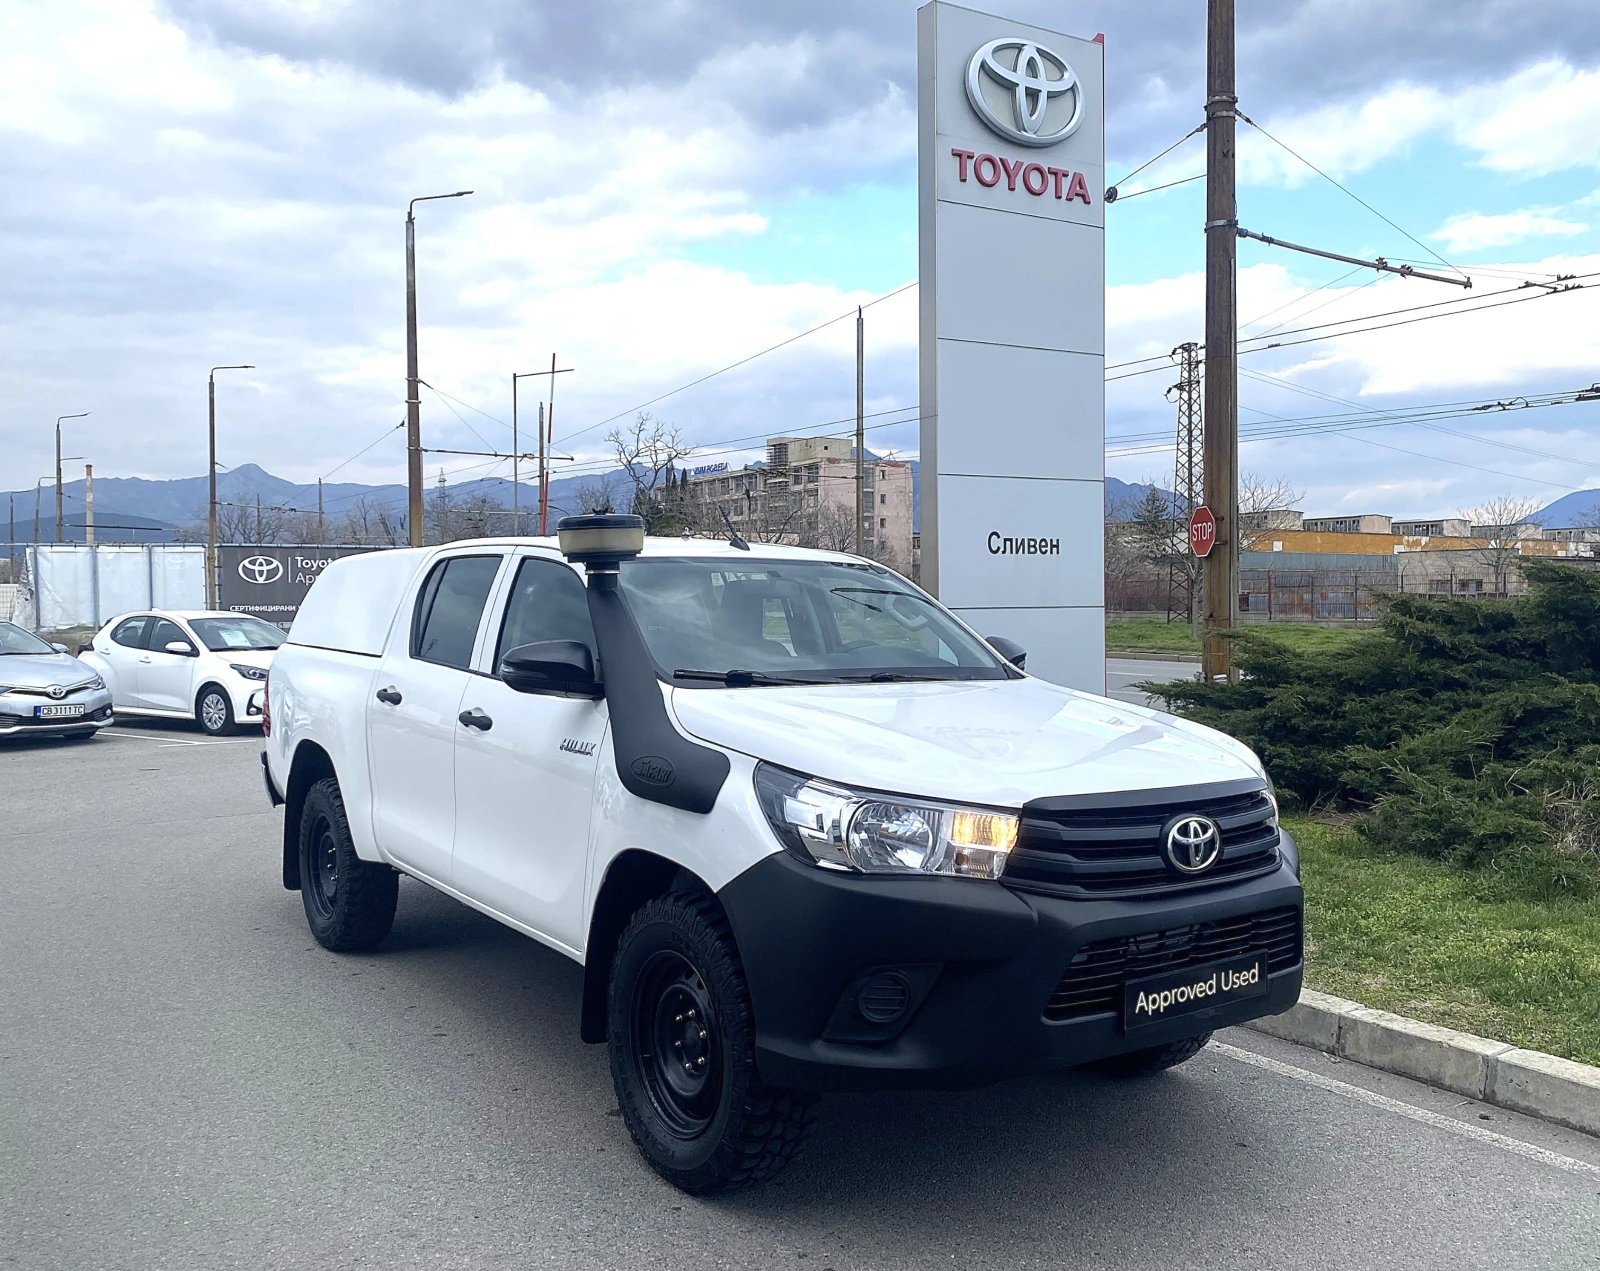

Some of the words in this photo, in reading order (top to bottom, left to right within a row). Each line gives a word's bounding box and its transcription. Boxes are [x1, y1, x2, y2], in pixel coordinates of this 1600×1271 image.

[951, 147, 1091, 205] TOYOTA
[987, 530, 1060, 555] Сливен
[1192, 521, 1213, 542] STOP
[229, 604, 296, 613] СЕРТИФИЦИРАНИ
[559, 737, 597, 757] HILUX
[633, 760, 672, 783] SAFARI
[1135, 972, 1217, 1016] Approved
[1221, 962, 1259, 991] Used
